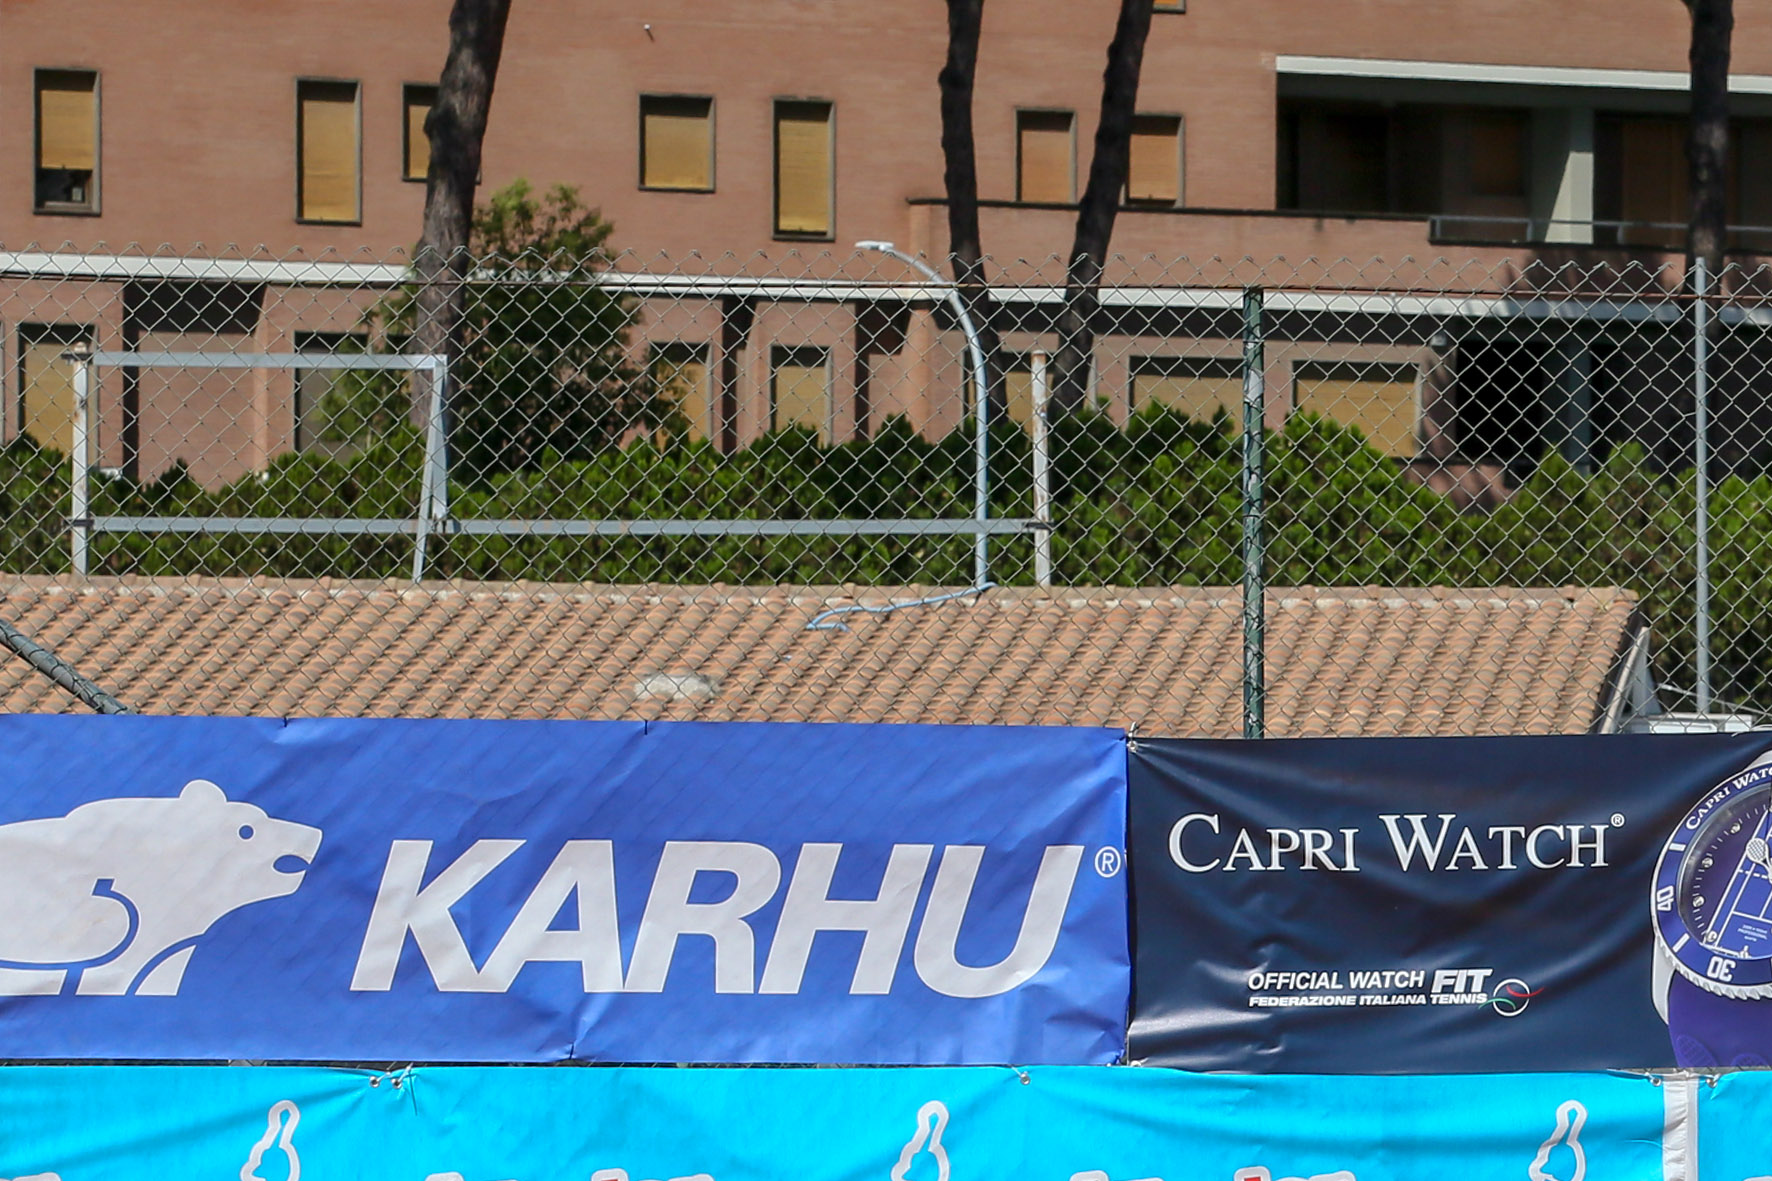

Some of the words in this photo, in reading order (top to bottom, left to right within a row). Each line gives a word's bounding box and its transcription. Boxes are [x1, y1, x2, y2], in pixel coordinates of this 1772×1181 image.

[1248, 972, 1344, 991] OFFICIAL
[1349, 969, 1425, 990] WATCH
[1431, 968, 1493, 994] FIT
[1248, 994, 1356, 1008] FEDERAZIONE
[1359, 994, 1425, 1006] ITALIANA
[1430, 992, 1488, 1005] TENNIS
